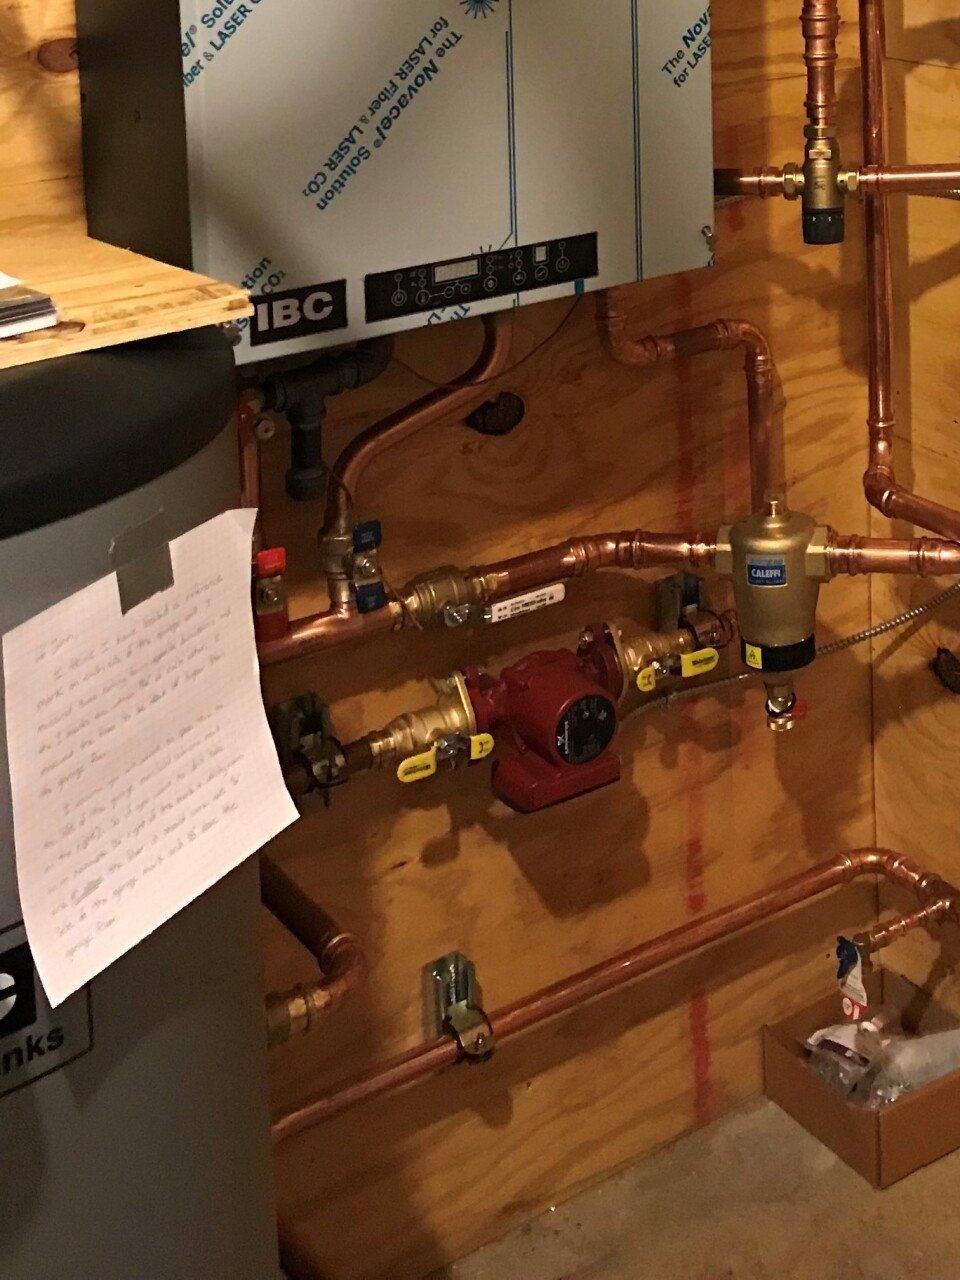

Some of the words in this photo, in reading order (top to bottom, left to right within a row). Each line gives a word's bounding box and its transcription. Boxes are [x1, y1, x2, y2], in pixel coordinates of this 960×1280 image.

[202, 51, 214, 61] &
[209, 4, 252, 51] LASER
[430, 16, 449, 38] for
[435, 31, 463, 57] The
[394, 36, 433, 80] LASER
[661, 50, 685, 74] The
[673, 68, 689, 88] for
[367, 79, 399, 116] Fiber
[323, 125, 364, 171] LASER
[316, 146, 371, 210] Solution
[257, 291, 333, 332] IBC
[751, 568, 781, 579] CALEFFI
